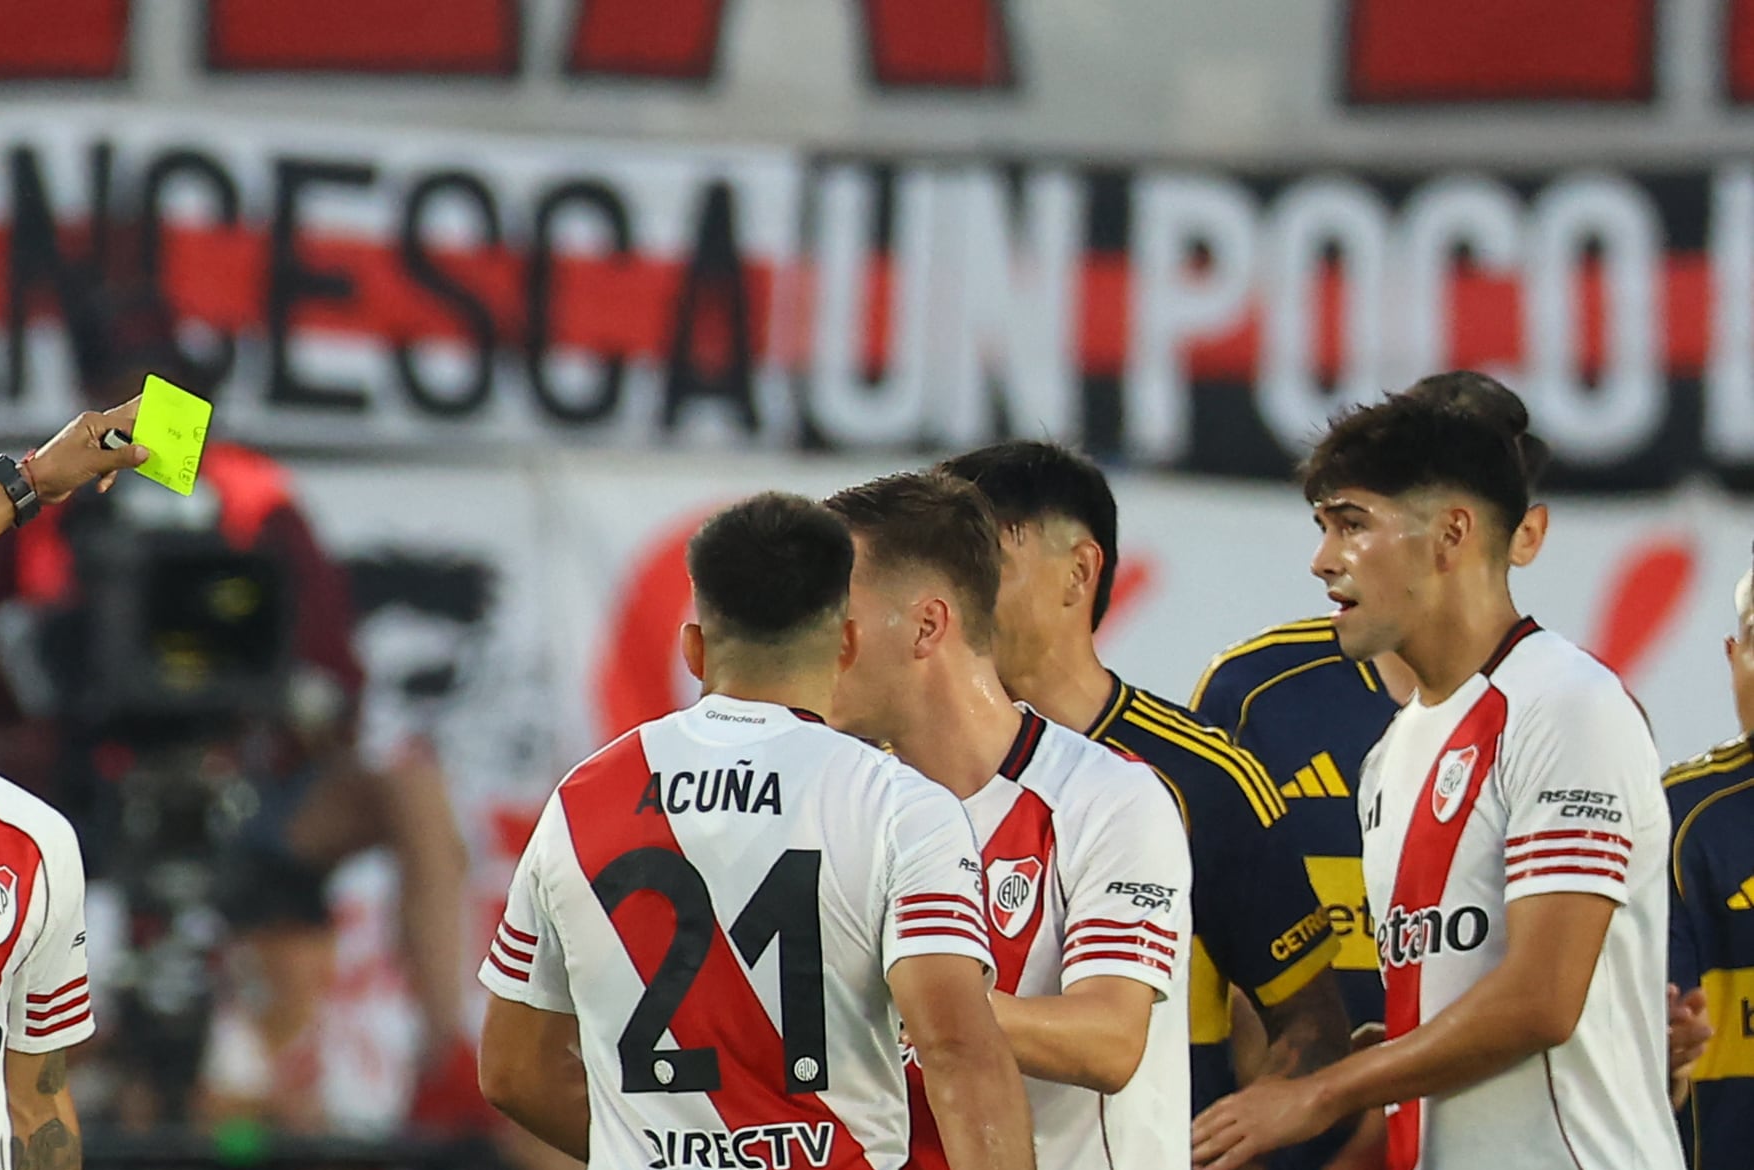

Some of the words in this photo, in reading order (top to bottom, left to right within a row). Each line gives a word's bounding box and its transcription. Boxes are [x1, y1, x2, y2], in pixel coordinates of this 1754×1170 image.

[810, 163, 1082, 452] UN
[1123, 167, 1667, 468] POCO
[634, 758, 783, 815] ACUÑA
[1536, 789, 1619, 807] ASSIST
[1560, 803, 1623, 824] CARD
[1376, 904, 1490, 968] etano
[590, 847, 829, 1095] 21
